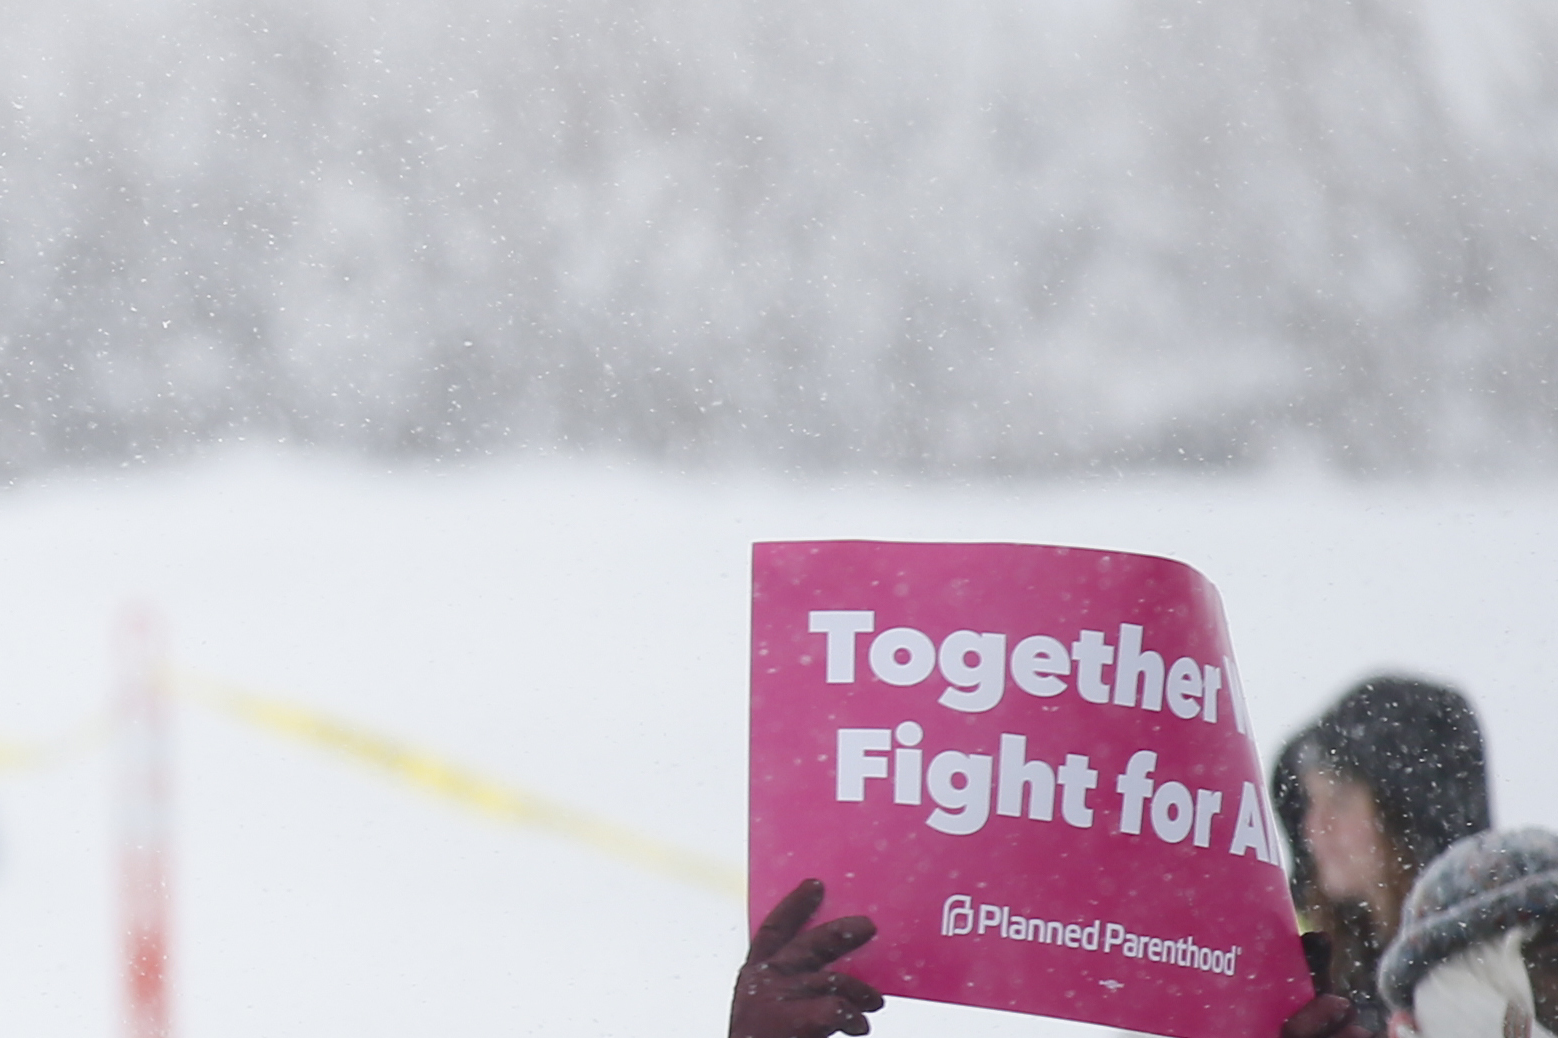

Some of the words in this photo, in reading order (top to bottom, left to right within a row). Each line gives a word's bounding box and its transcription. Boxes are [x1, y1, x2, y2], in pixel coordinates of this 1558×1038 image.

[808, 610, 1221, 724] Together
[836, 721, 1099, 836] Fight
[1116, 750, 1223, 849] for
[977, 903, 1101, 951] Planned
